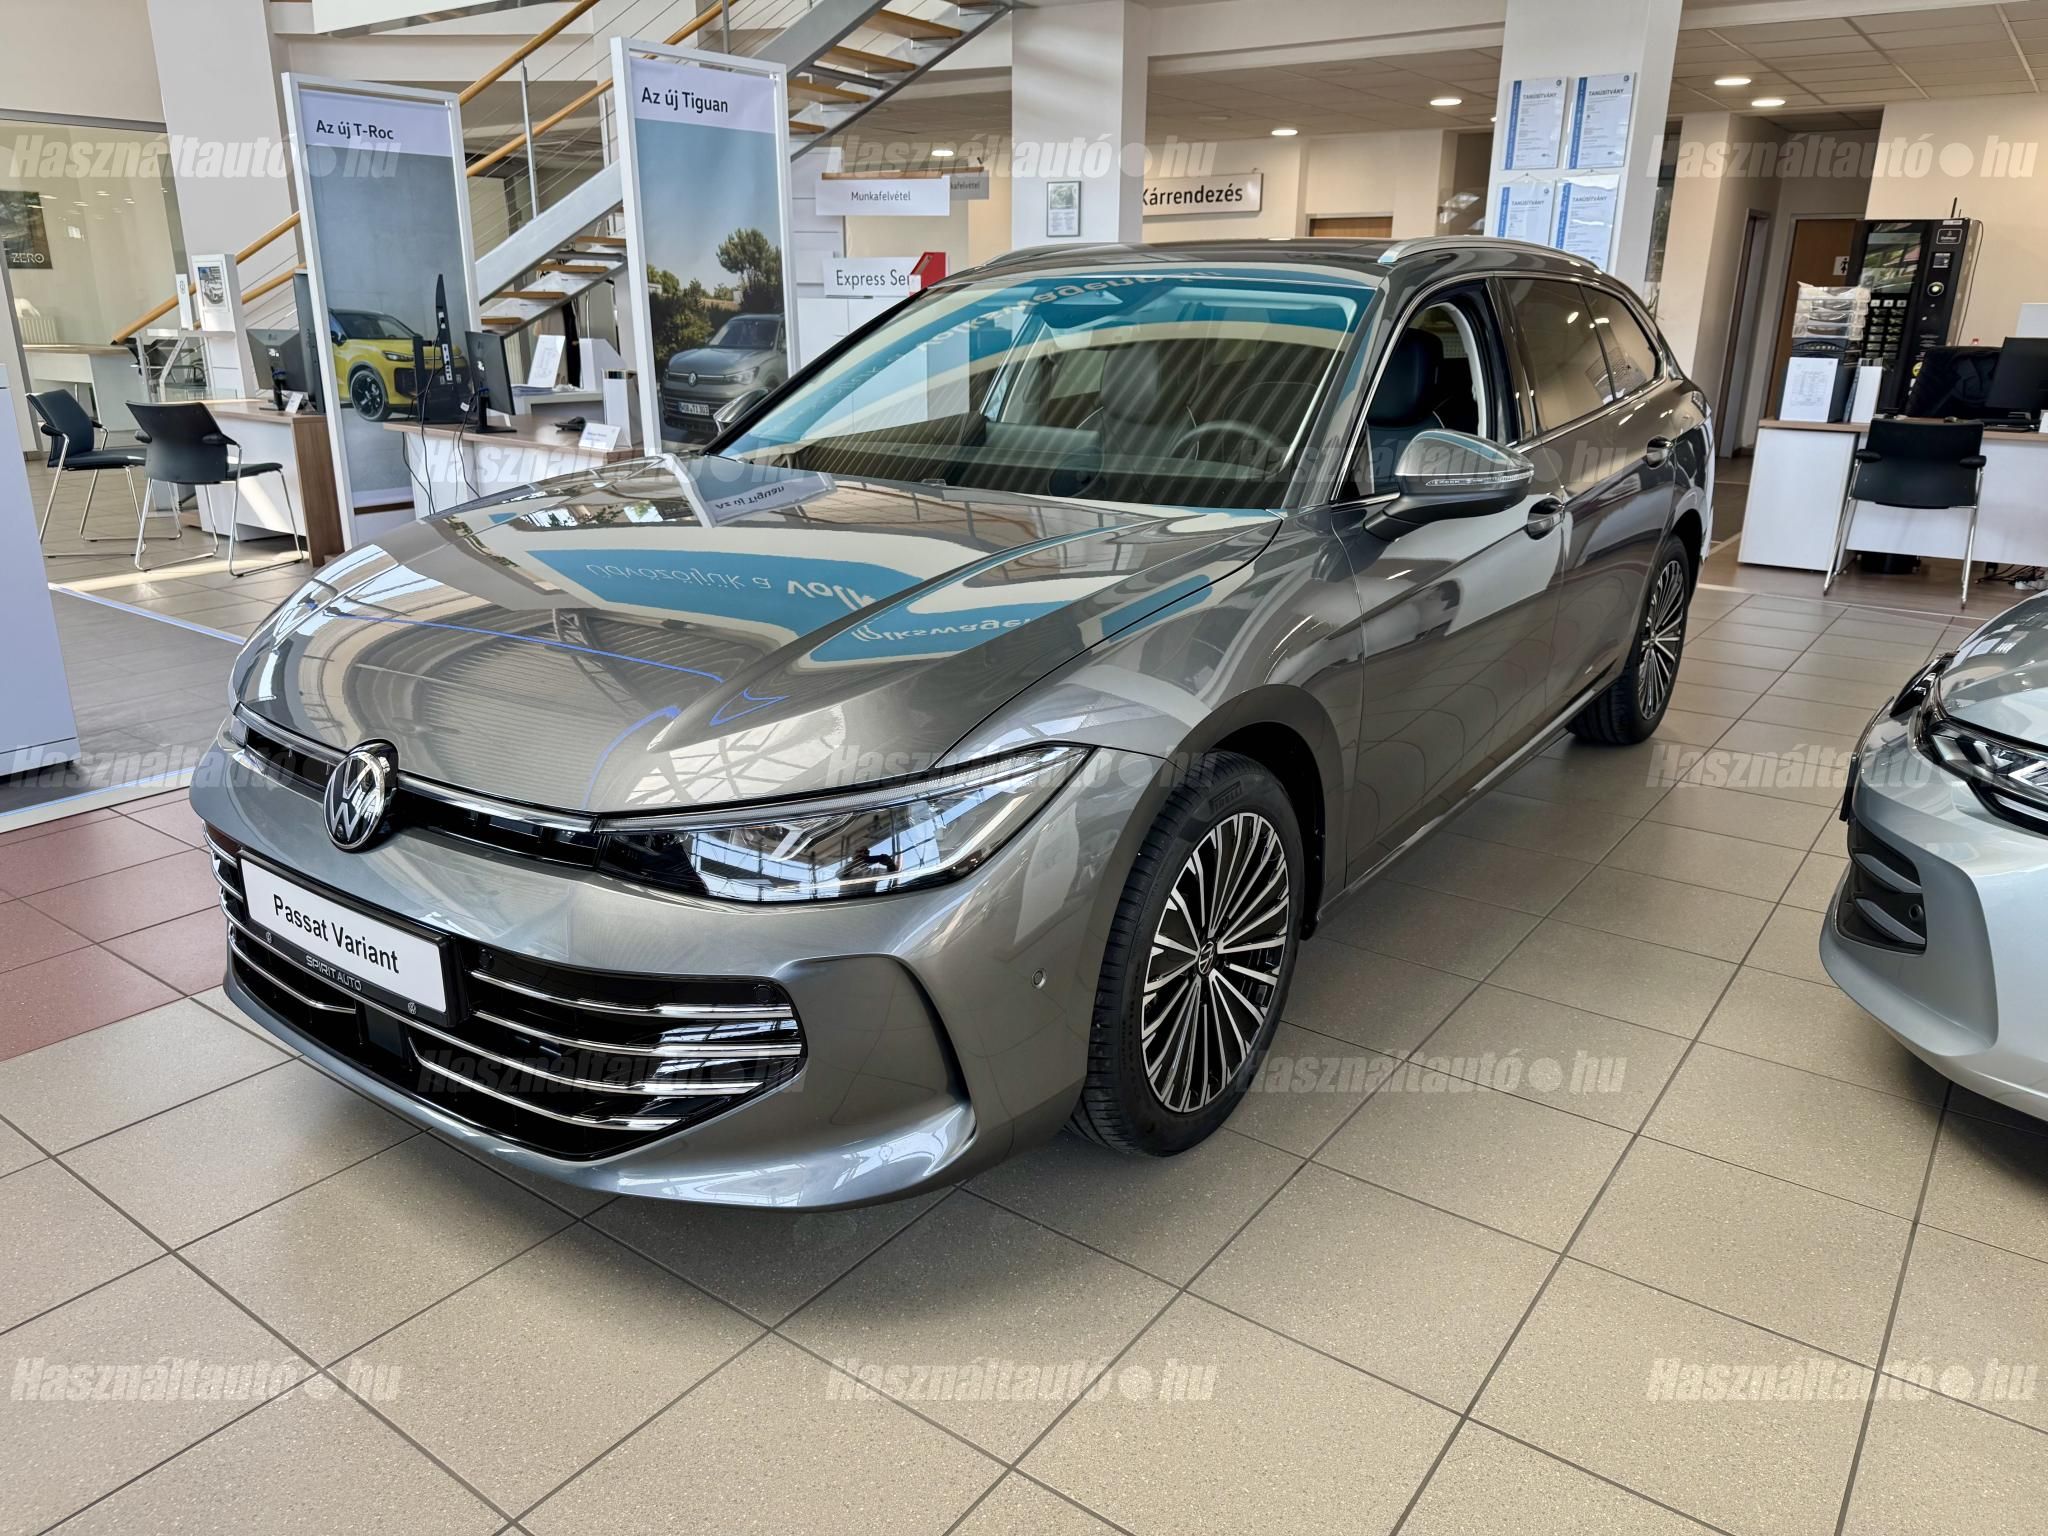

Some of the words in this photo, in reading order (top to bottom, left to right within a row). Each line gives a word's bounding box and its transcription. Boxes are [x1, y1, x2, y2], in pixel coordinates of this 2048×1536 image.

[641, 86, 661, 105] Az
[664, 88, 679, 111] új
[682, 91, 729, 114] Tiguan
[316, 119, 335, 134] Az
[338, 120, 351, 139] új
[353, 123, 394, 140] T-Roc
[851, 191, 911, 201] Munkafelvétel
[11, 252, 45, 264] ZERO
[836, 270, 886, 290] Express
[273, 893, 329, 941] Passat
[331, 922, 400, 973] Variant
[305, 954, 337, 979] SPIRIT
[337, 969, 362, 991] AUTO
